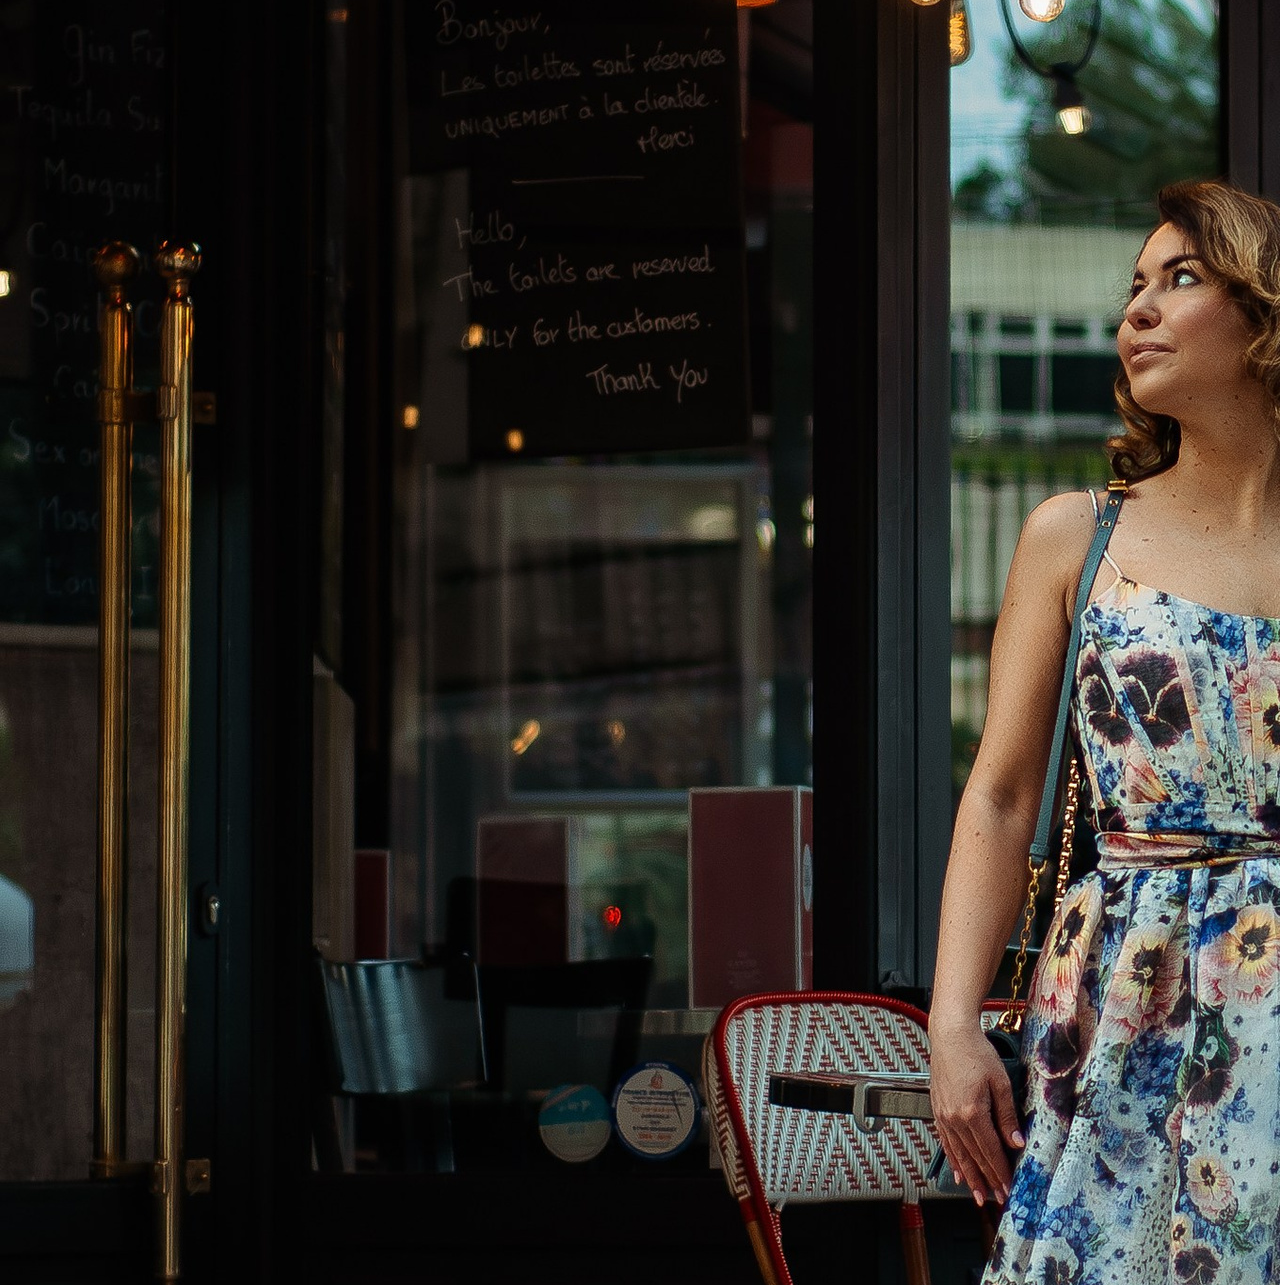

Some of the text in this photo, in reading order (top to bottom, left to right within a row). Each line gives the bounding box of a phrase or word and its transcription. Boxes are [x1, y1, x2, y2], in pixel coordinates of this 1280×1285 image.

[440, 69, 486, 97] Les
[494, 51, 582, 88] toilettes
[592, 43, 636, 78] sont
[7, 84, 115, 143] Tequila
[444, 103, 570, 139] UNIQUEMENT
[636, 125, 695, 154] Merci
[454, 209, 528, 251] Hello,
[442, 243, 716, 302] The toilets are reserved
[533, 317, 561, 347] for
[567, 309, 604, 343] the
[585, 358, 709, 405] Thank You
